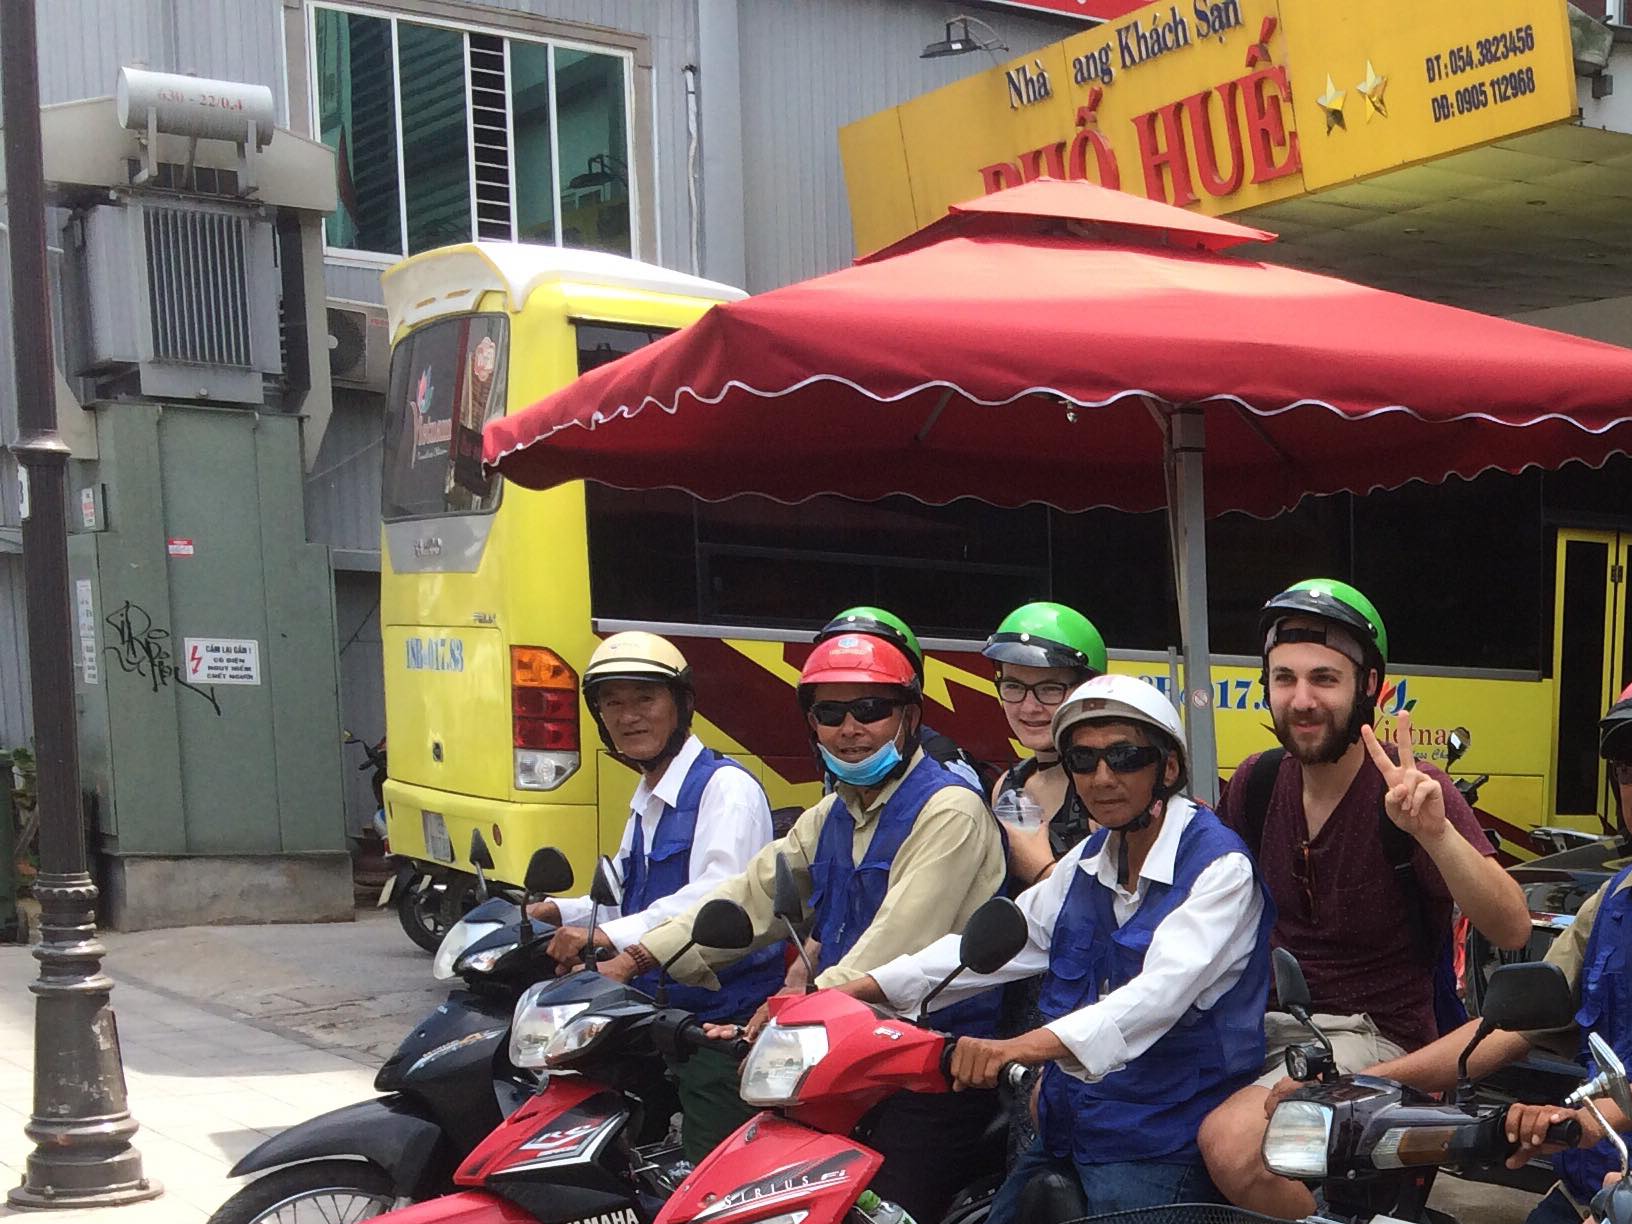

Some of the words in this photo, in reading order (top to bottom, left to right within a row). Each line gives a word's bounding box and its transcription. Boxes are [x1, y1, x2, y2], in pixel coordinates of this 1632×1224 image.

[1006, 60, 1052, 111] Nhà
[1115, 6, 1192, 71] Khách
[1192, 0, 1244, 44] Sạn
[1455, 82, 1488, 115] 0905
[1489, 66, 1536, 105] 112968
[1130, 16, 1304, 208] HUẾ
[724, 1175, 809, 1207] SIRIUS
